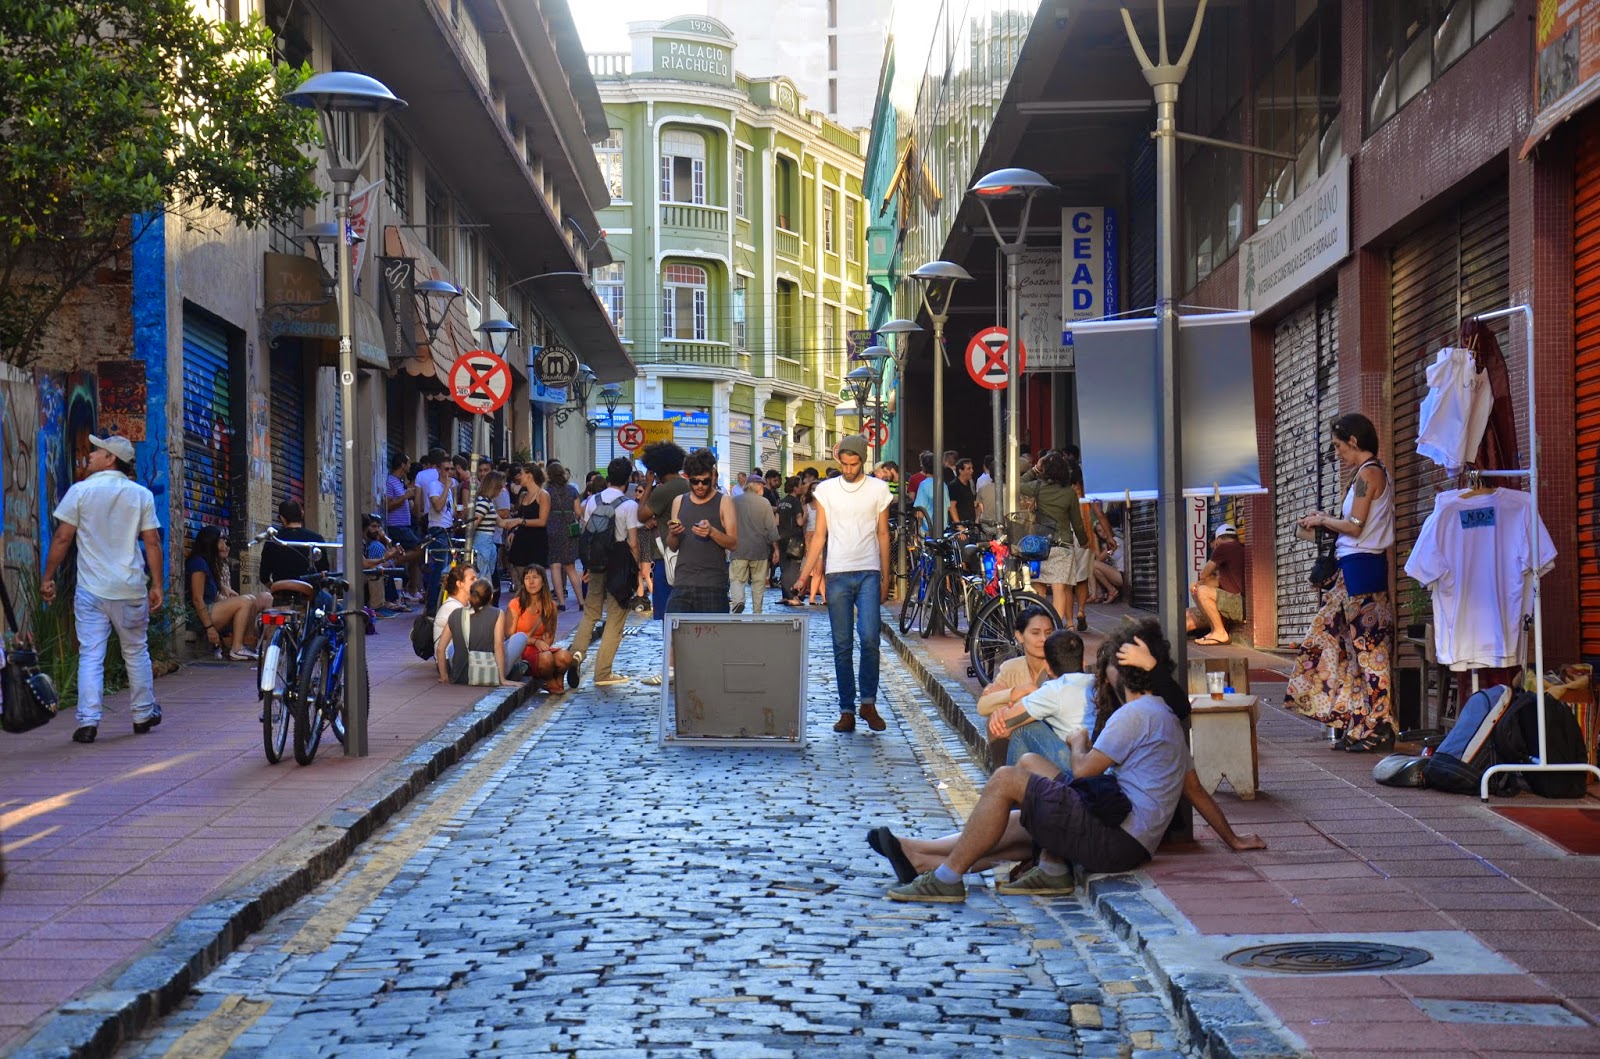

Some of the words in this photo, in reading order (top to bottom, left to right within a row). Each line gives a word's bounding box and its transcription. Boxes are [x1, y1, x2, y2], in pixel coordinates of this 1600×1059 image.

[691, 20, 712, 32] 1929
[670, 42, 723, 61] PALACIO
[661, 55, 727, 77] RIACHUELO
[1105, 216, 1113, 247] POTY
[1291, 205, 1312, 246] MONTE
[1071, 212, 1093, 310] CEAD
[1020, 277, 1060, 287] Costura
[1105, 251, 1114, 318] LAZZAROTT
[642, 427, 669, 436] TENÇÃO
